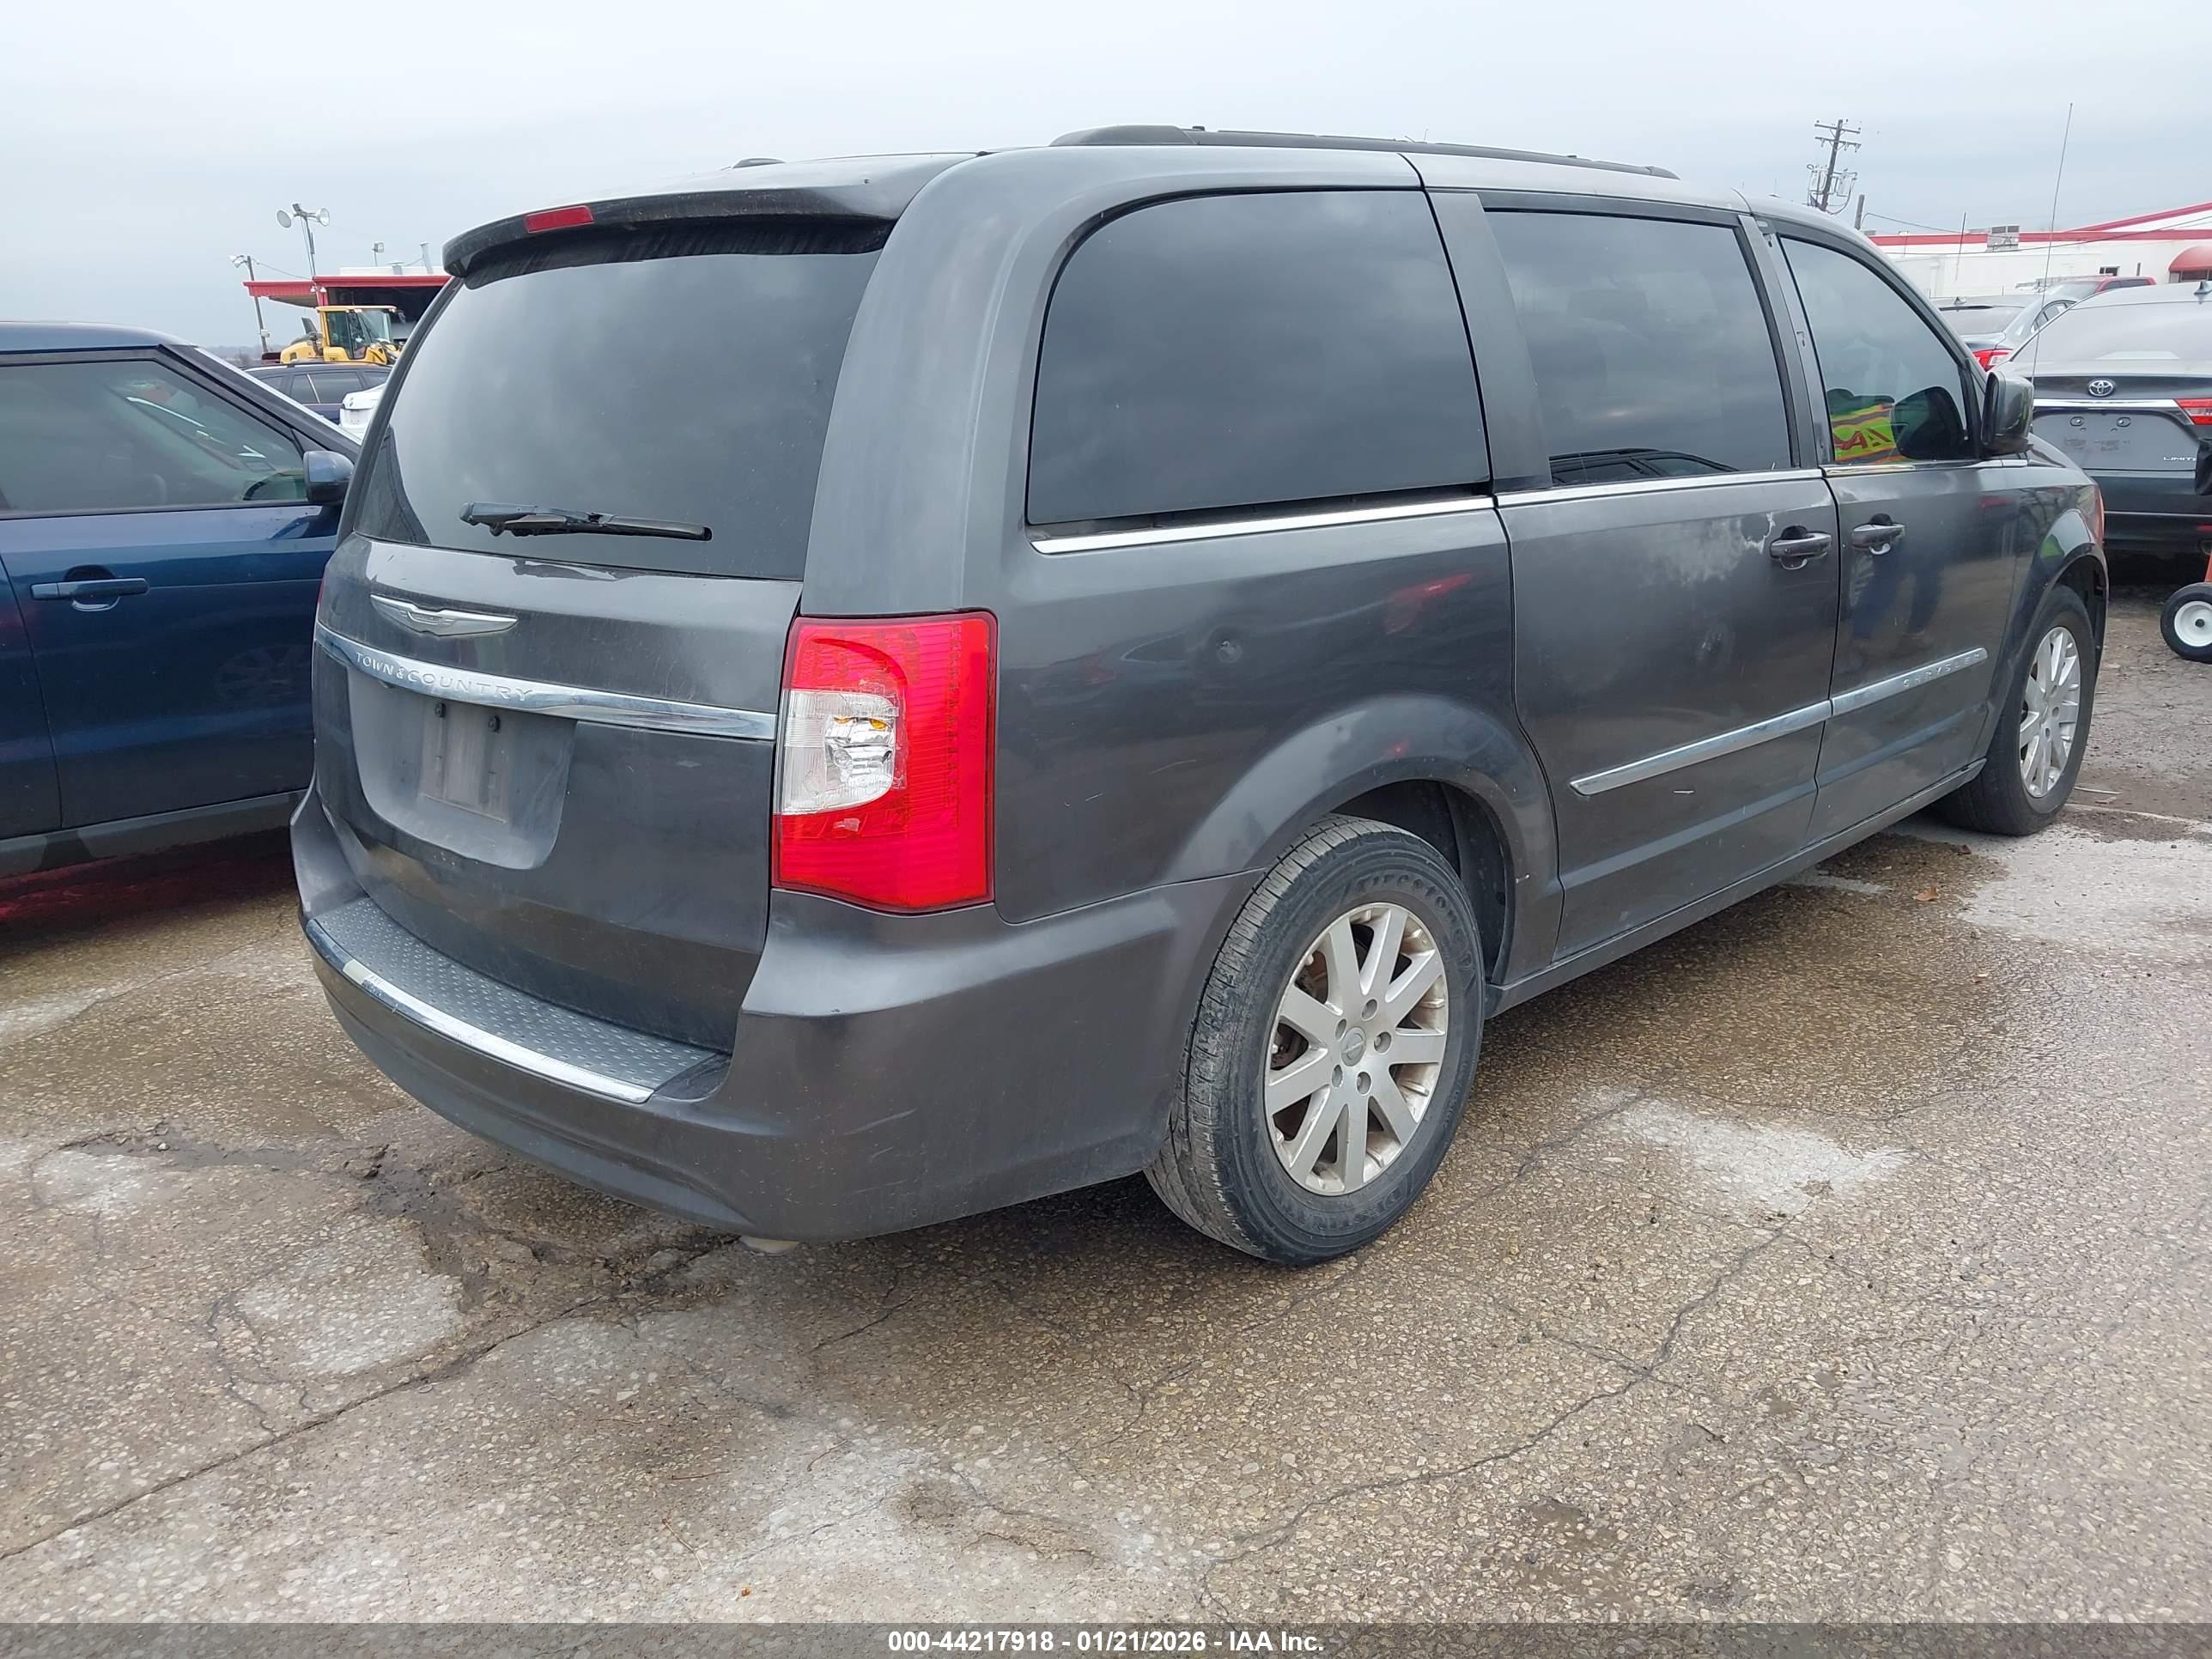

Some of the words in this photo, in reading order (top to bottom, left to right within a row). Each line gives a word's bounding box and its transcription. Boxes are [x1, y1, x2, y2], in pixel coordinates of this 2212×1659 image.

[356, 652, 394, 676] TOWN
[407, 669, 533, 702] COUNTRY
[1902, 653, 1980, 688] CHRYSLER
